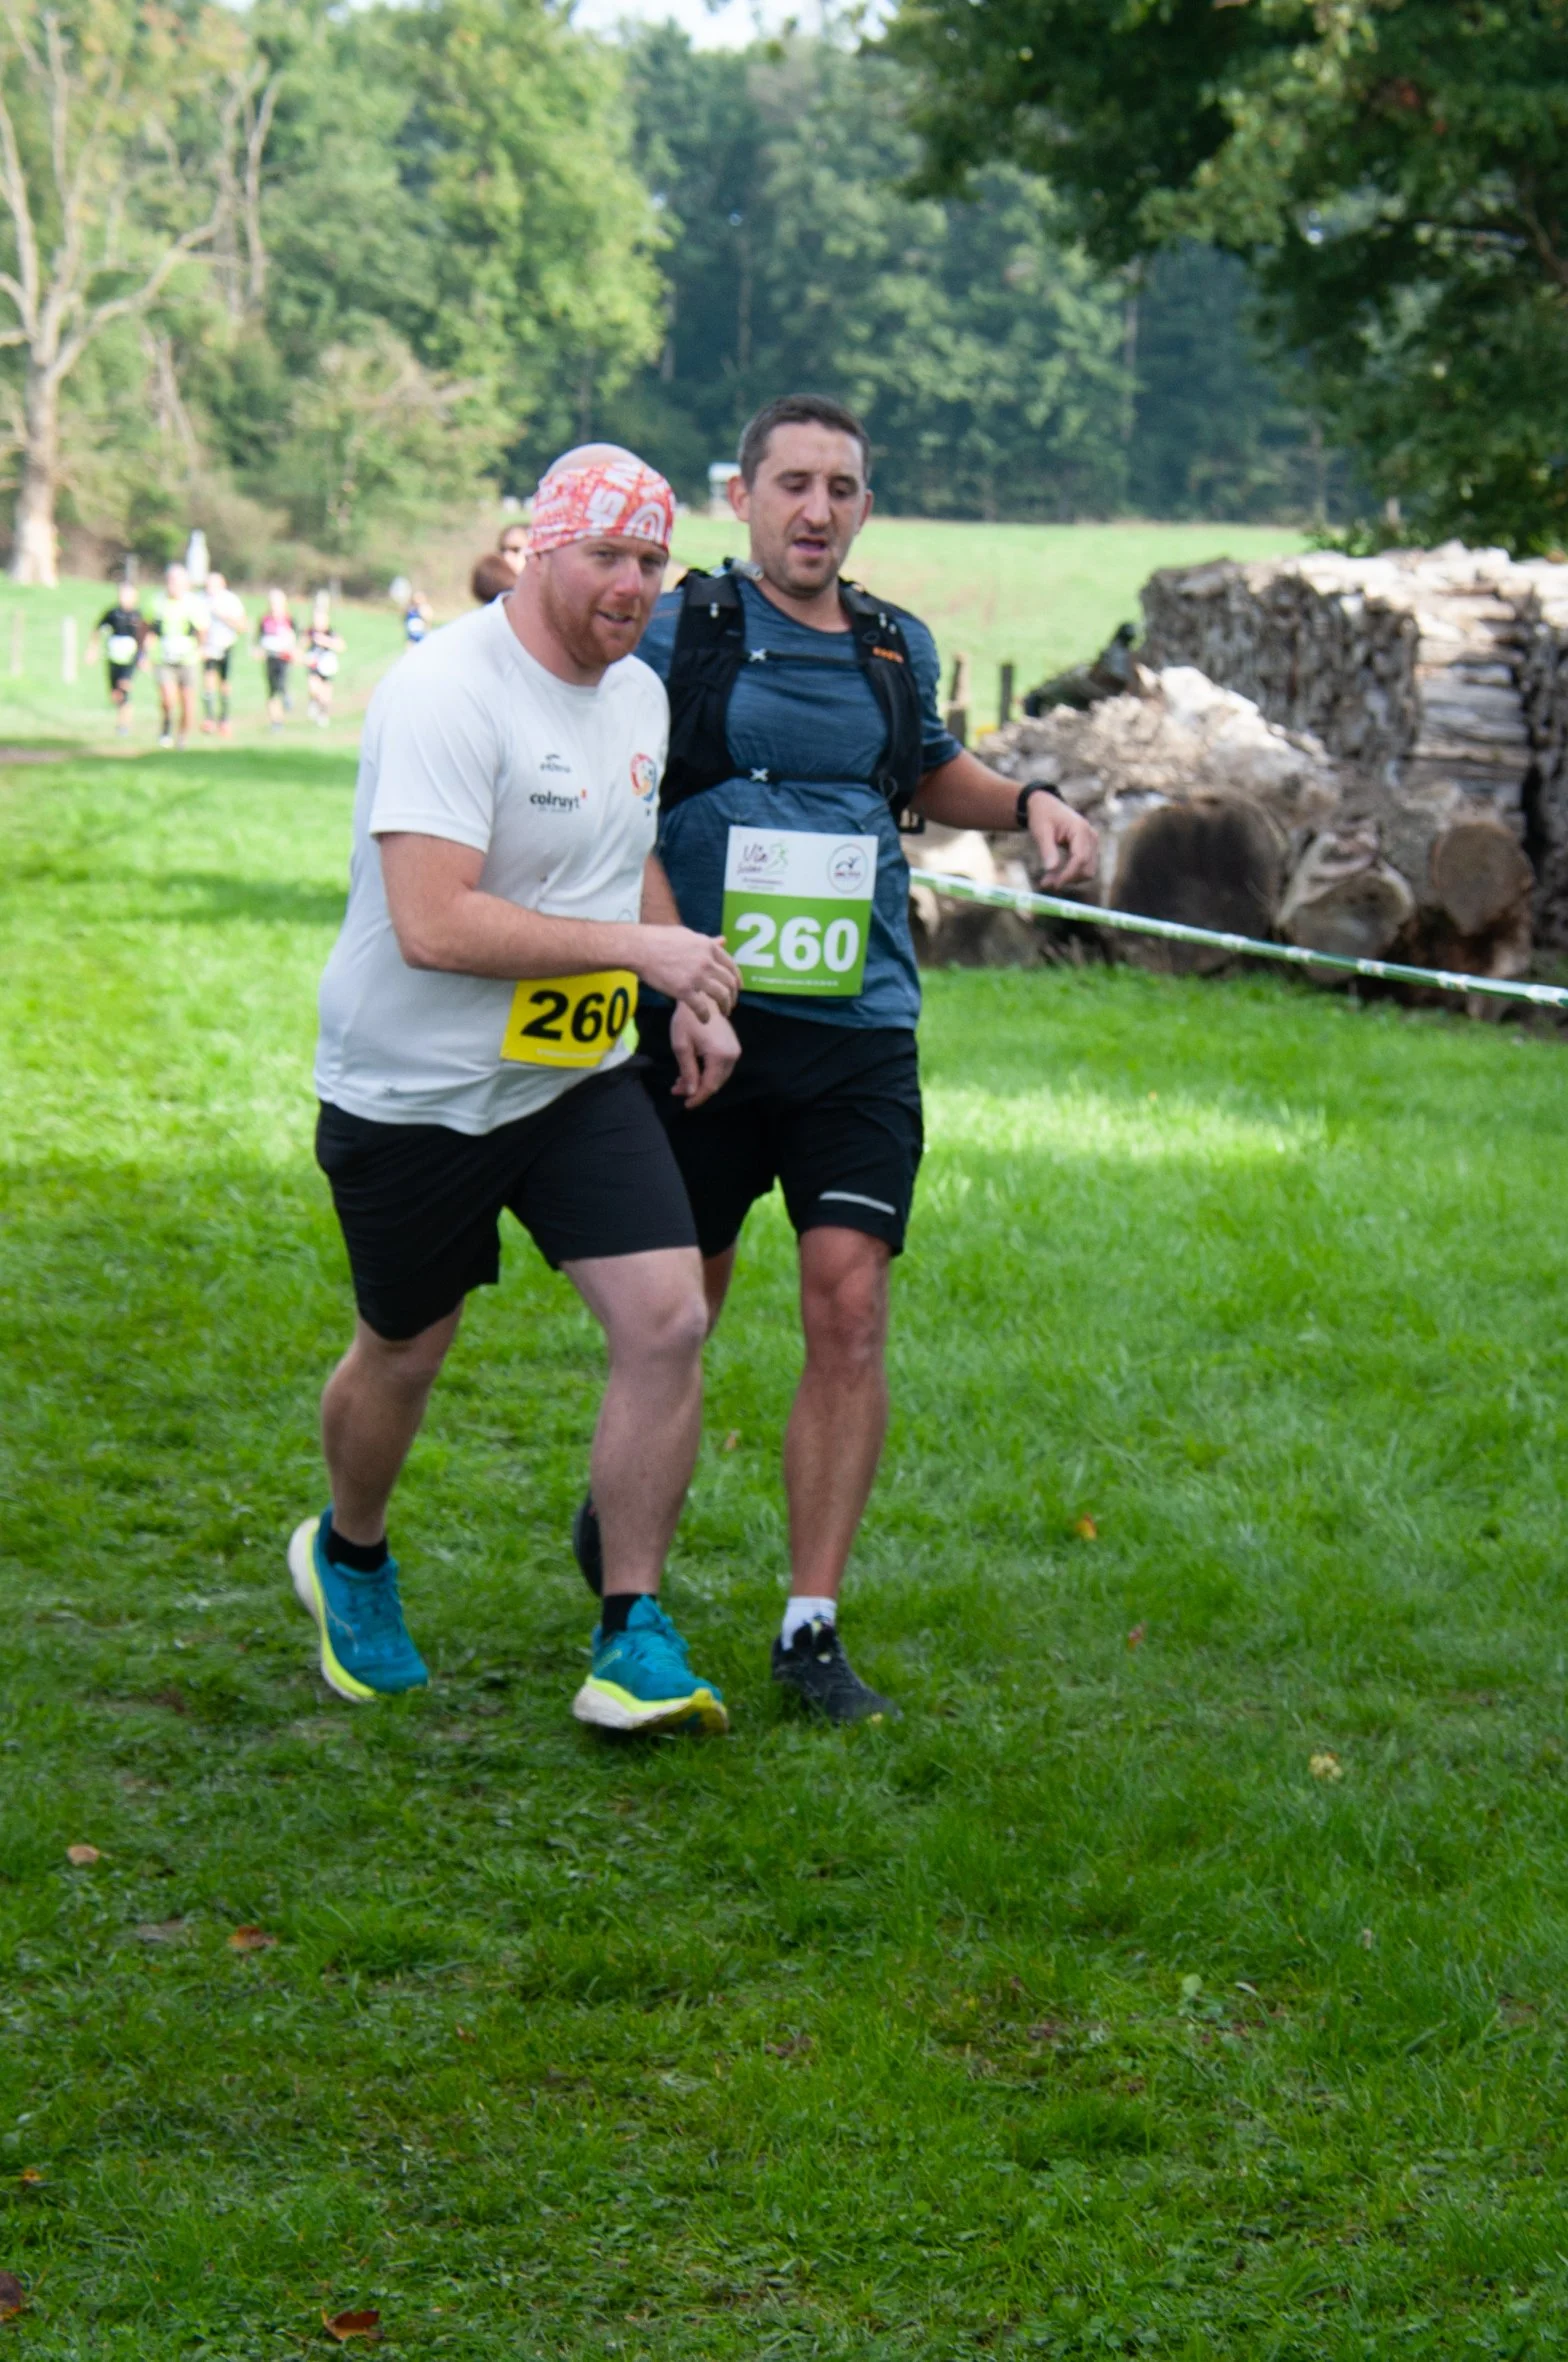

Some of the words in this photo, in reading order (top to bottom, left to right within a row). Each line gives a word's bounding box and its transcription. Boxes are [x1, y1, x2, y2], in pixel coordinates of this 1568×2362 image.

[530, 790, 580, 811] colruyt
[733, 912, 860, 973] 260
[520, 987, 629, 1043] 260
